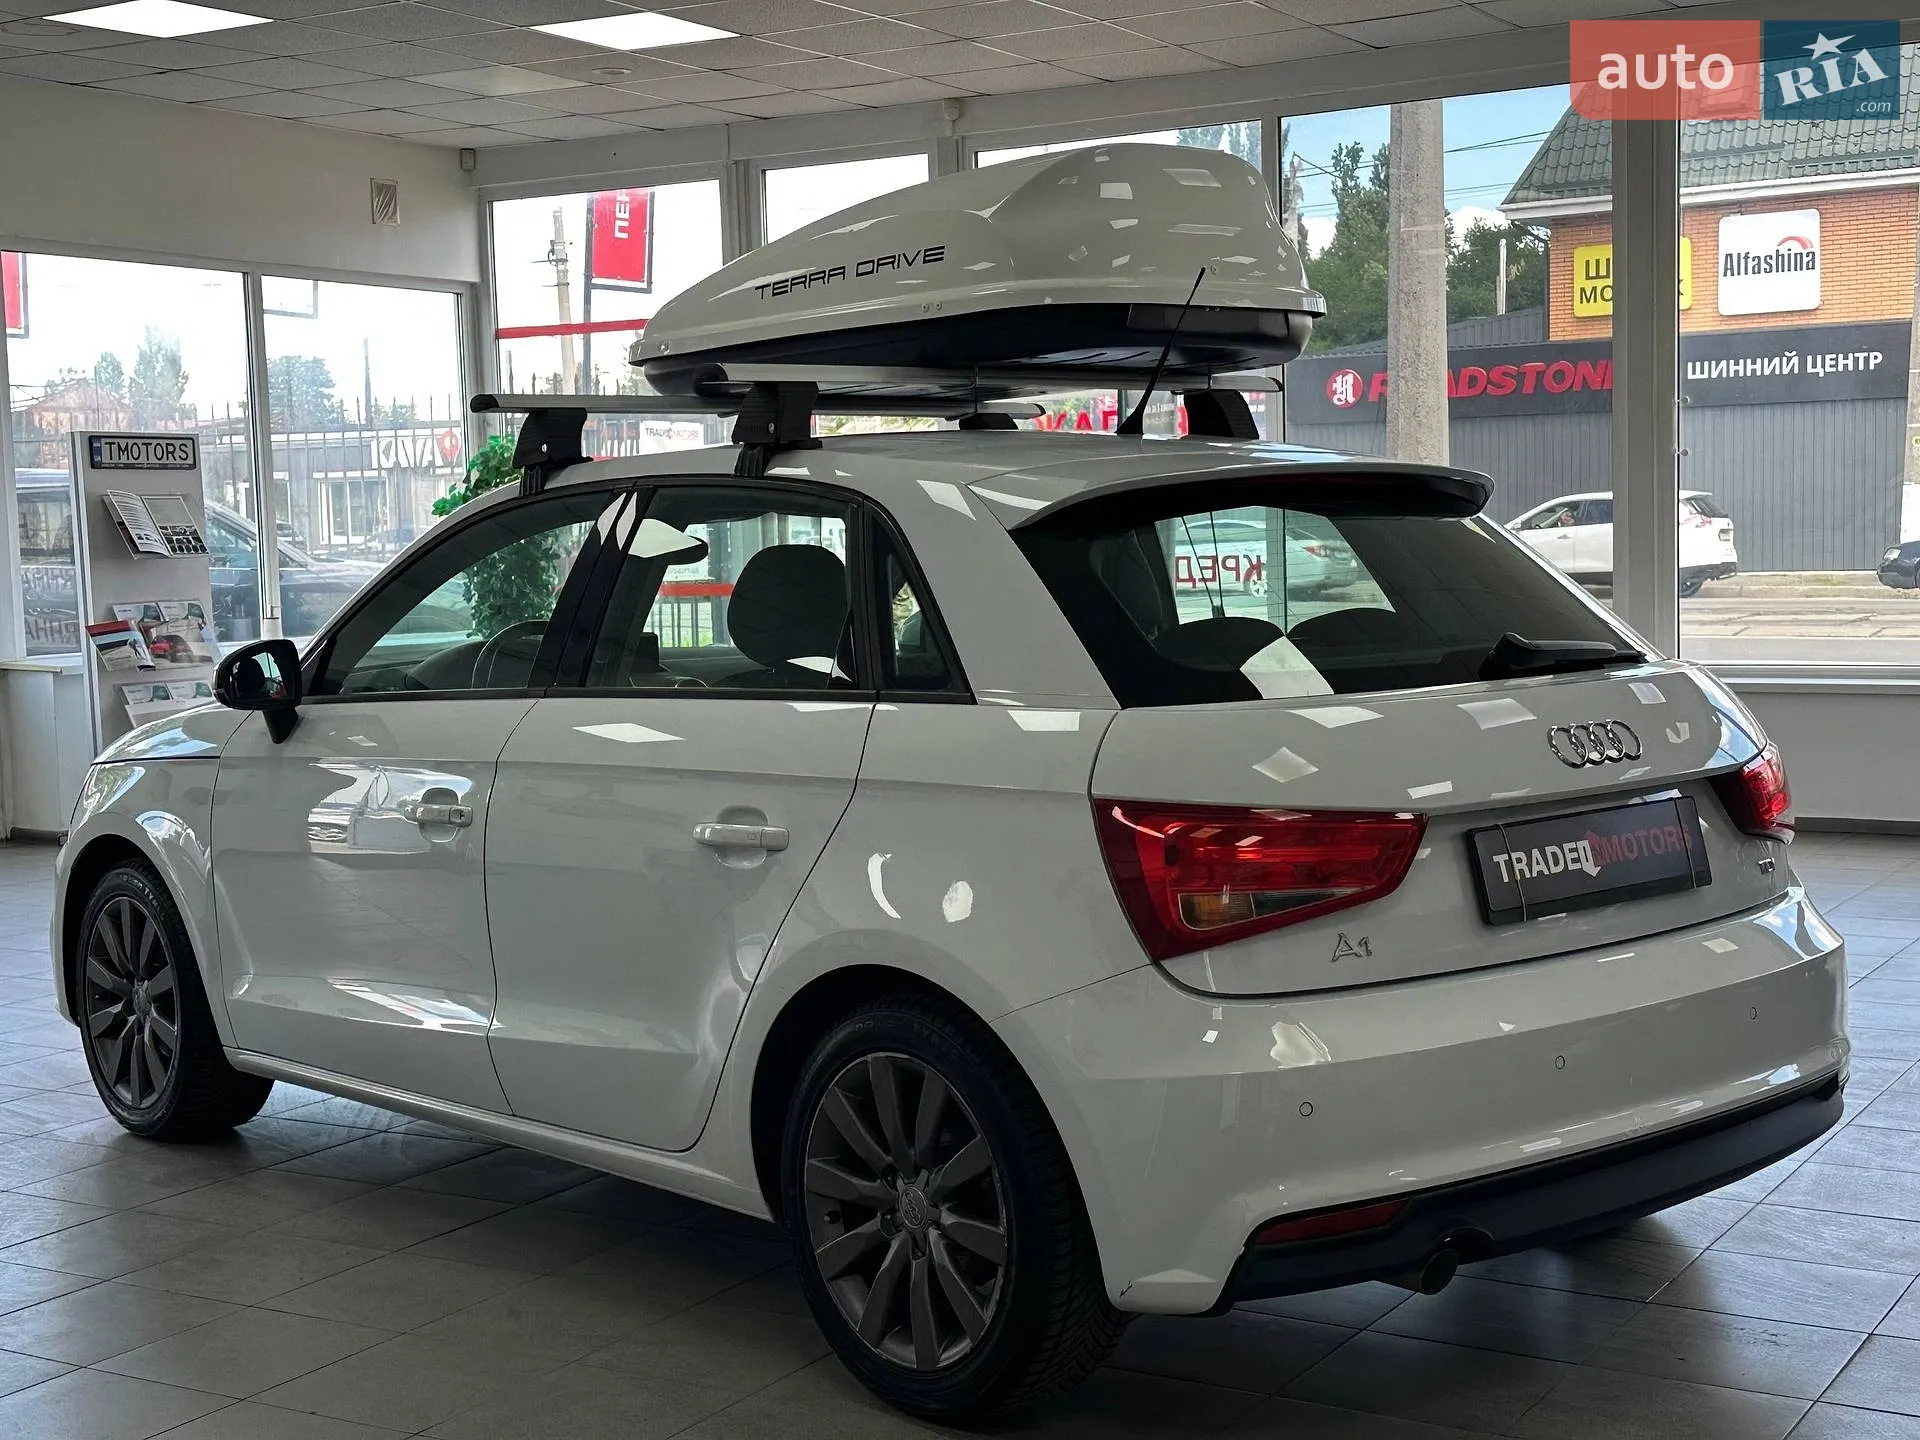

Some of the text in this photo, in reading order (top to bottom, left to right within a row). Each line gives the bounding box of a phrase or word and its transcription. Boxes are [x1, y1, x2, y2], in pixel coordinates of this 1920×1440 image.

[754, 245, 946, 300] TERRA DRIVE
[1722, 248, 1817, 277] Alfashina
[1686, 350, 1884, 380] ШИННИЙ ЦЕНТР
[1367, 360, 1614, 403] RDSTON
[104, 441, 189, 462] TMOTORS
[1330, 932, 1373, 963] A1
